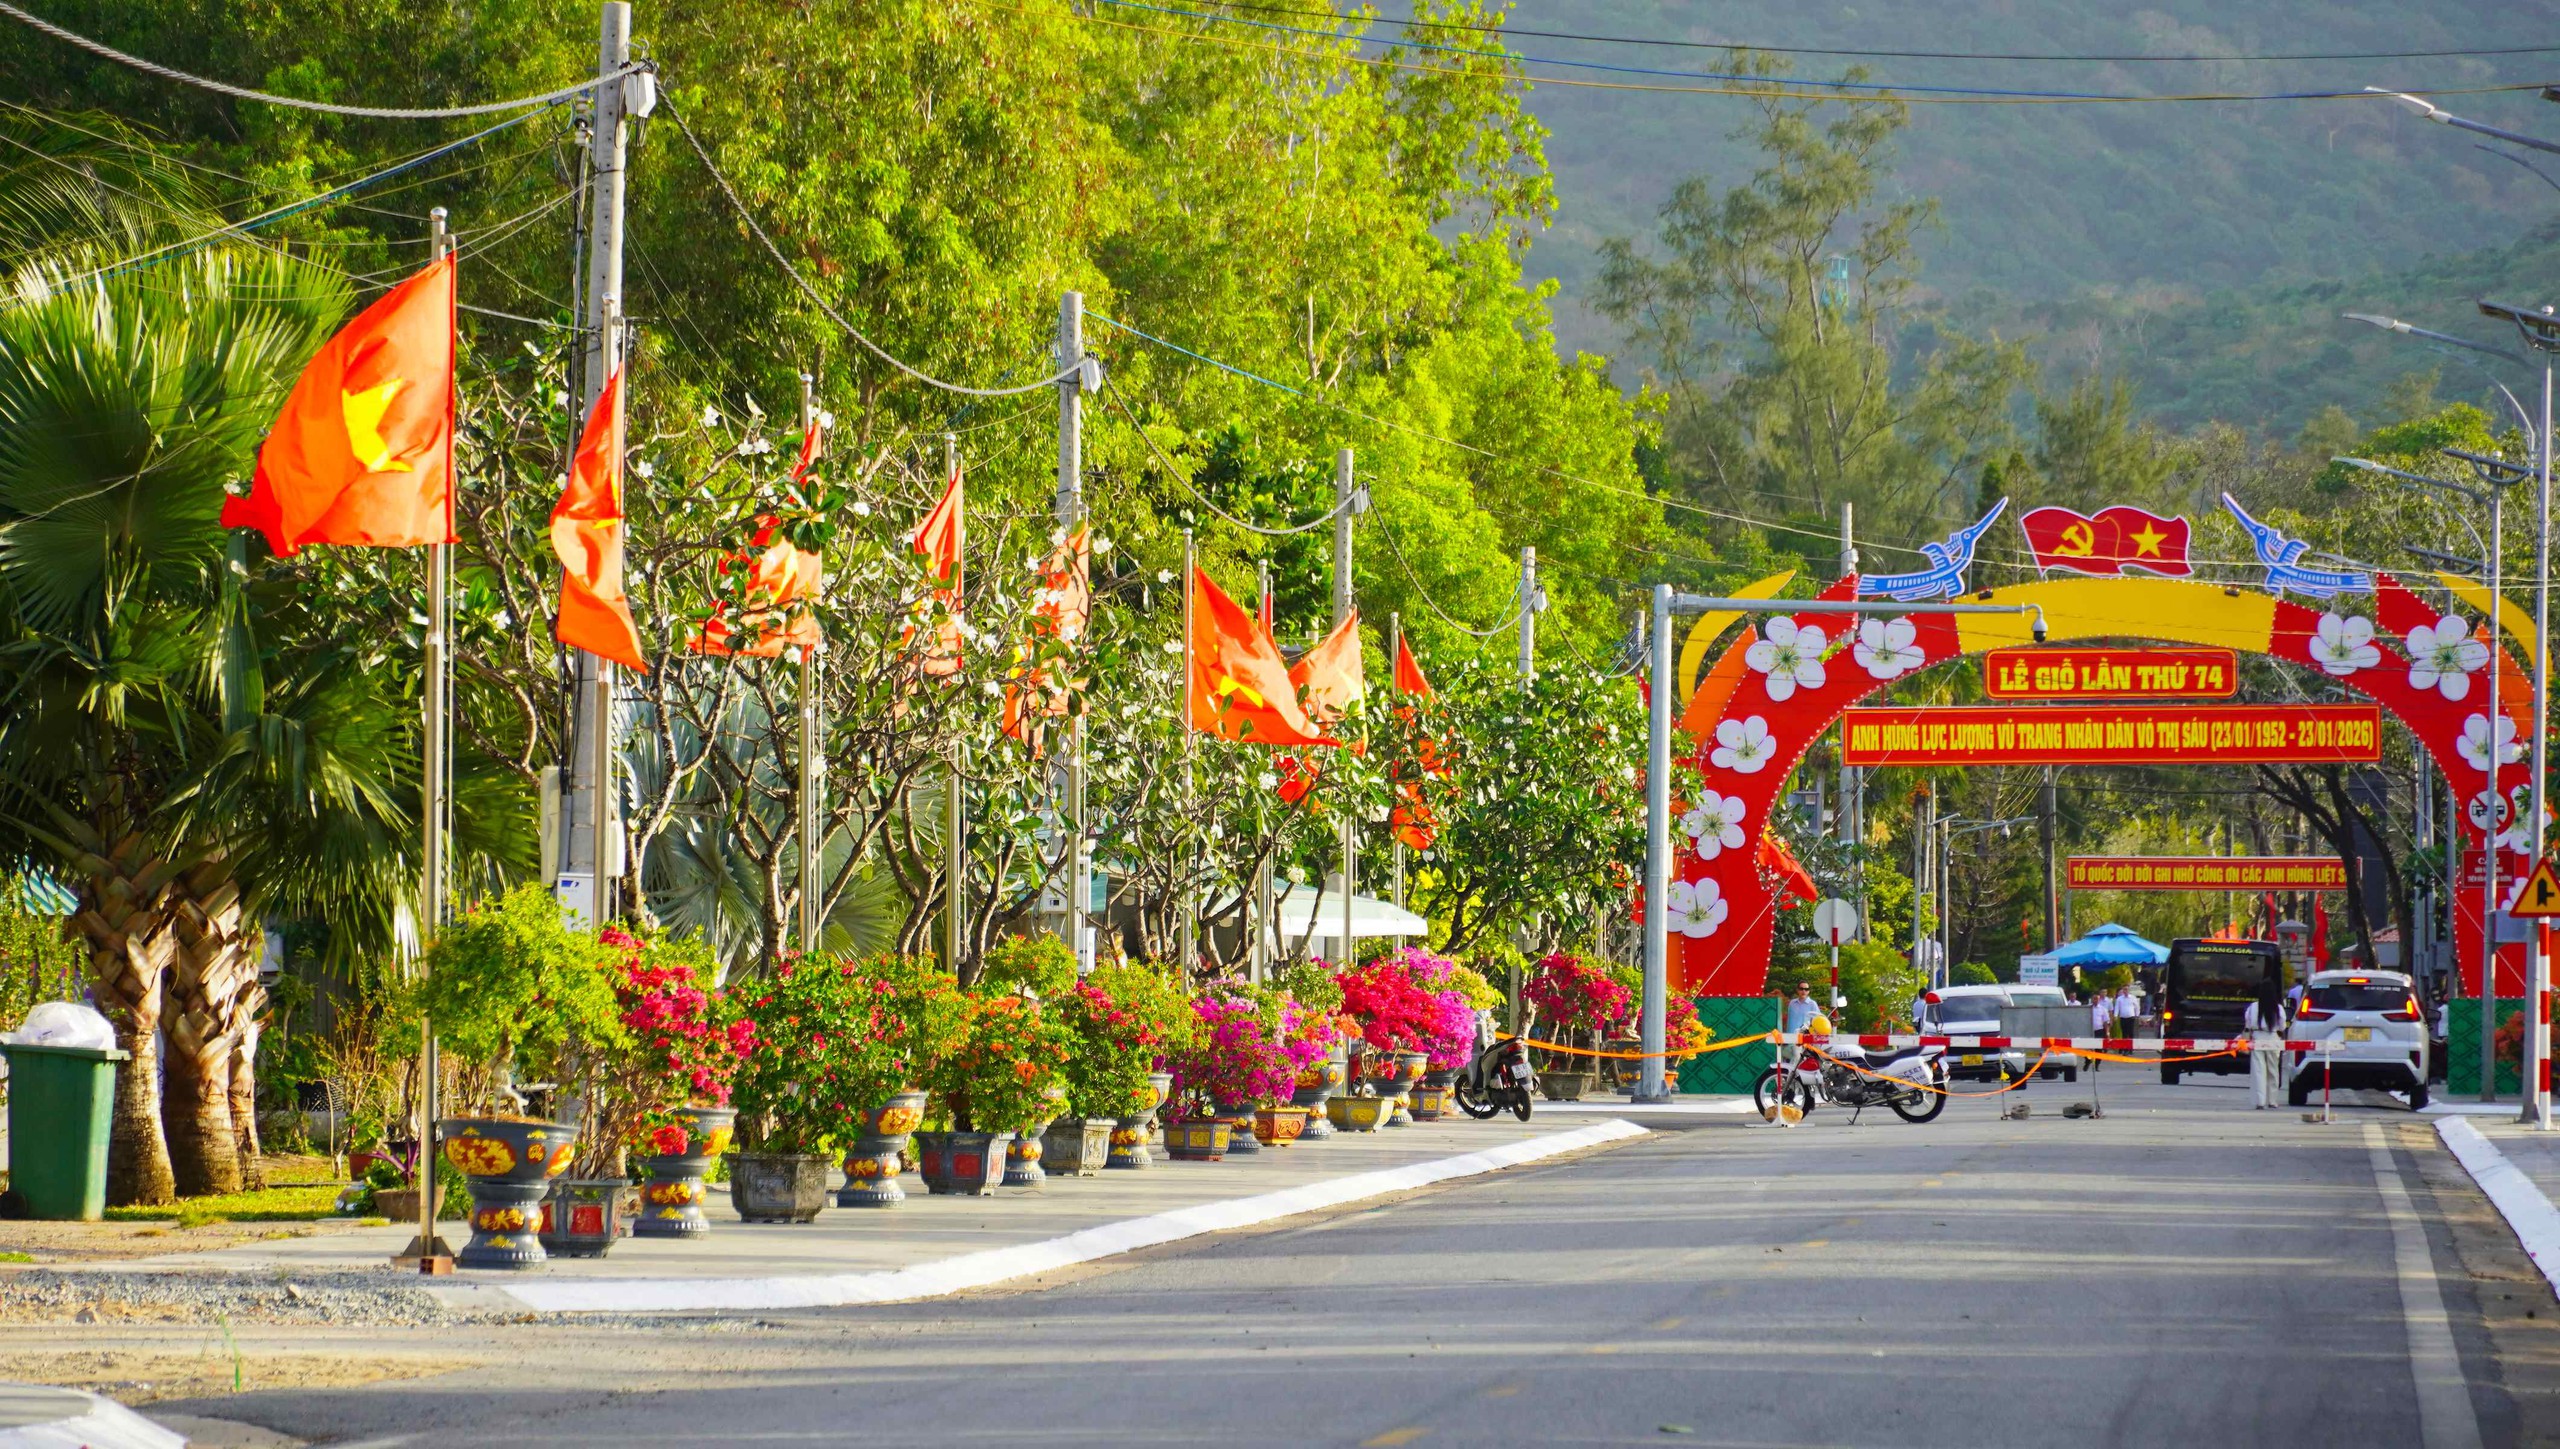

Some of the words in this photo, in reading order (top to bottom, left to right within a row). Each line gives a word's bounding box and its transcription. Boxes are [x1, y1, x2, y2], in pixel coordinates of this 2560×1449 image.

[1999, 658, 2029, 690] LỄ
[2035, 657, 2075, 690] GIỖ
[2081, 656, 2131, 690] LẦN
[2137, 661, 2189, 690] THỨ
[2194, 665, 2223, 690] 74
[1851, 724, 1880, 751] ANH
[1882, 719, 1919, 751] HÙNG
[1921, 724, 1947, 755] LỰC
[1949, 724, 1994, 755] LƯỢNG
[1997, 718, 2015, 750] VŨ
[2018, 723, 2062, 750] TRANG
[2065, 717, 2104, 750] NHÂN
[2106, 717, 2135, 749] DÂN
[2136, 717, 2154, 748] VÕ
[2157, 722, 2180, 752] THỊ
[2182, 717, 2208, 748] SÁU
[2211, 721, 2287, 751] (23/01/1952
[2289, 731, 2296, 740] -
[2298, 720, 2374, 750] 23/01/2026)
[2072, 861, 2086, 882] TỔ
[2087, 861, 2115, 883] QUỐC
[2116, 864, 2133, 882] ĐỜI
[2135, 864, 2152, 882] ĐỜI
[2154, 866, 2171, 882] GHI
[2173, 864, 2195, 882] NHỚ
[2196, 864, 2223, 883] CÔNG
[2225, 866, 2240, 883] ƠN
[2241, 864, 2262, 883] CÁC
[2264, 867, 2285, 883] ANH
[2286, 864, 2314, 883] HÙNG
[2316, 864, 2336, 886] LIỆT
[2338, 866, 2346, 883] S
